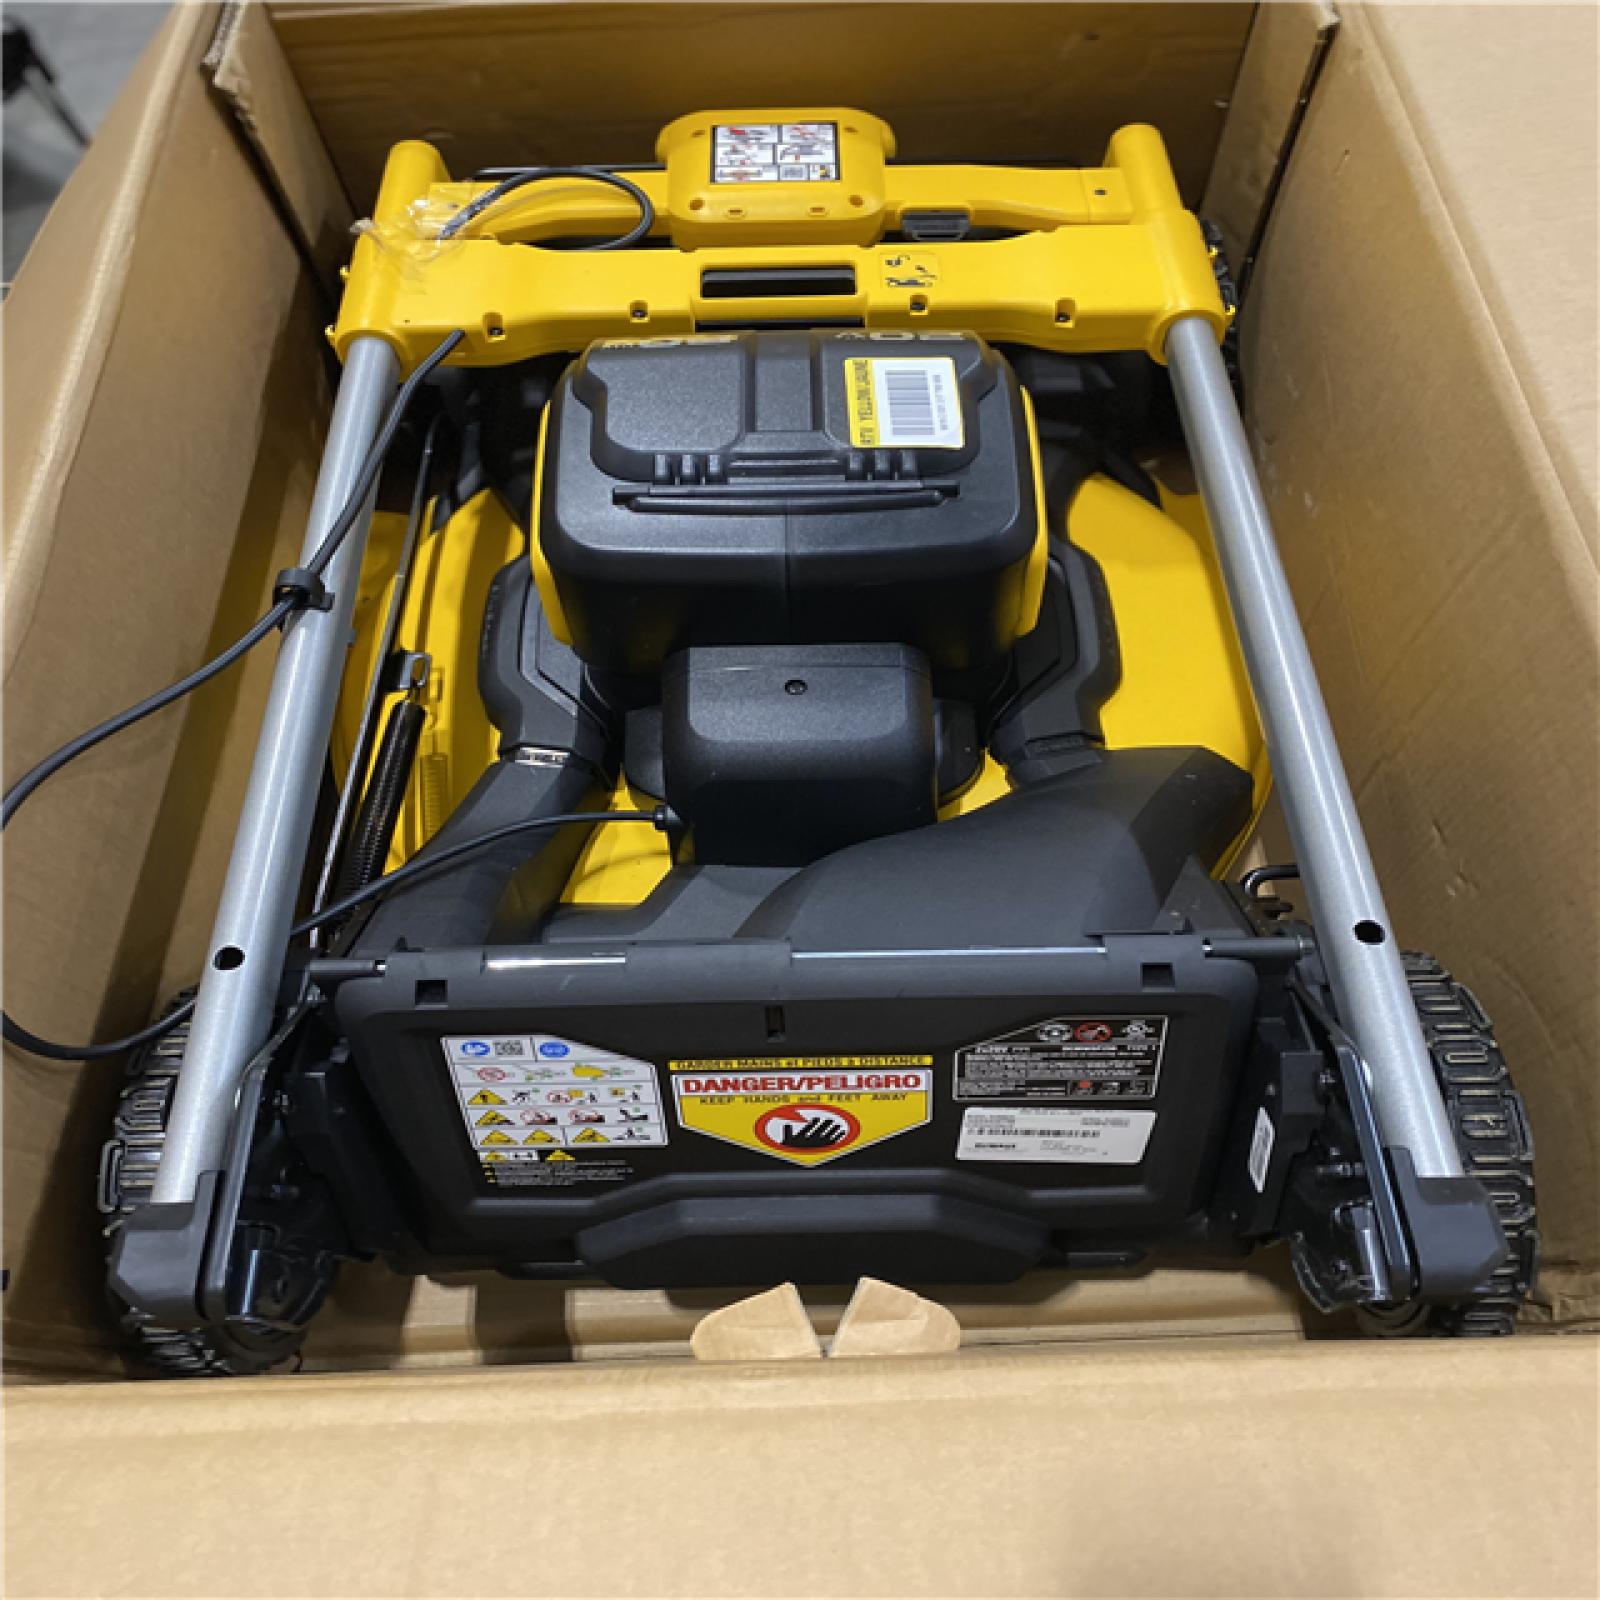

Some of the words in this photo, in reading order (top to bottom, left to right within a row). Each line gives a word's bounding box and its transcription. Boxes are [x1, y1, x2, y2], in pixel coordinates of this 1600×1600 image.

[802, 1057, 843, 1067] PIEDS
[861, 1055, 924, 1065] DISTANCE
[682, 1074, 921, 1092] DANGER/PELIGRO
[699, 1095, 735, 1105] KEEP
[744, 1095, 791, 1104] HANDS
[829, 1093, 861, 1102] FEET
[871, 1092, 908, 1101] AWAY
